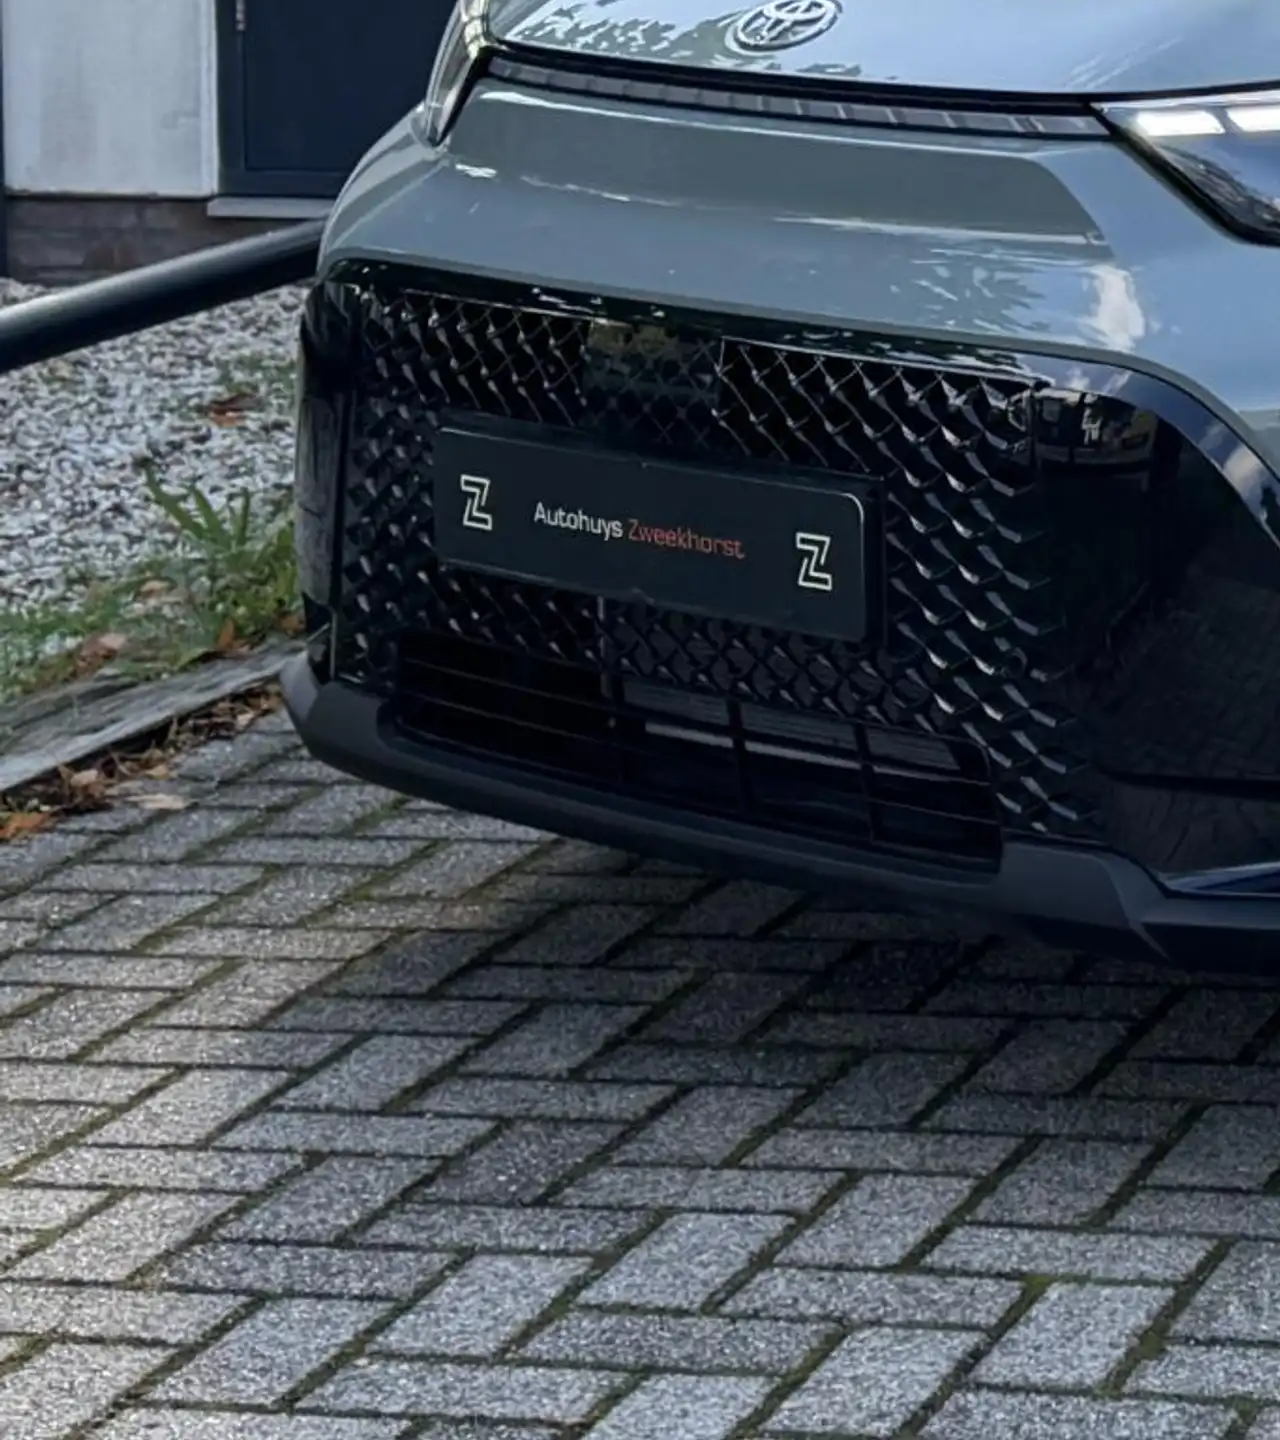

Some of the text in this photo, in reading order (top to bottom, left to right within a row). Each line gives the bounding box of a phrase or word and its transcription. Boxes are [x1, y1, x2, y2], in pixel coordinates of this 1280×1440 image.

[459, 473, 493, 531] Z
[533, 501, 745, 559] Autohuys Zweekhorst
[795, 531, 833, 592] Z
